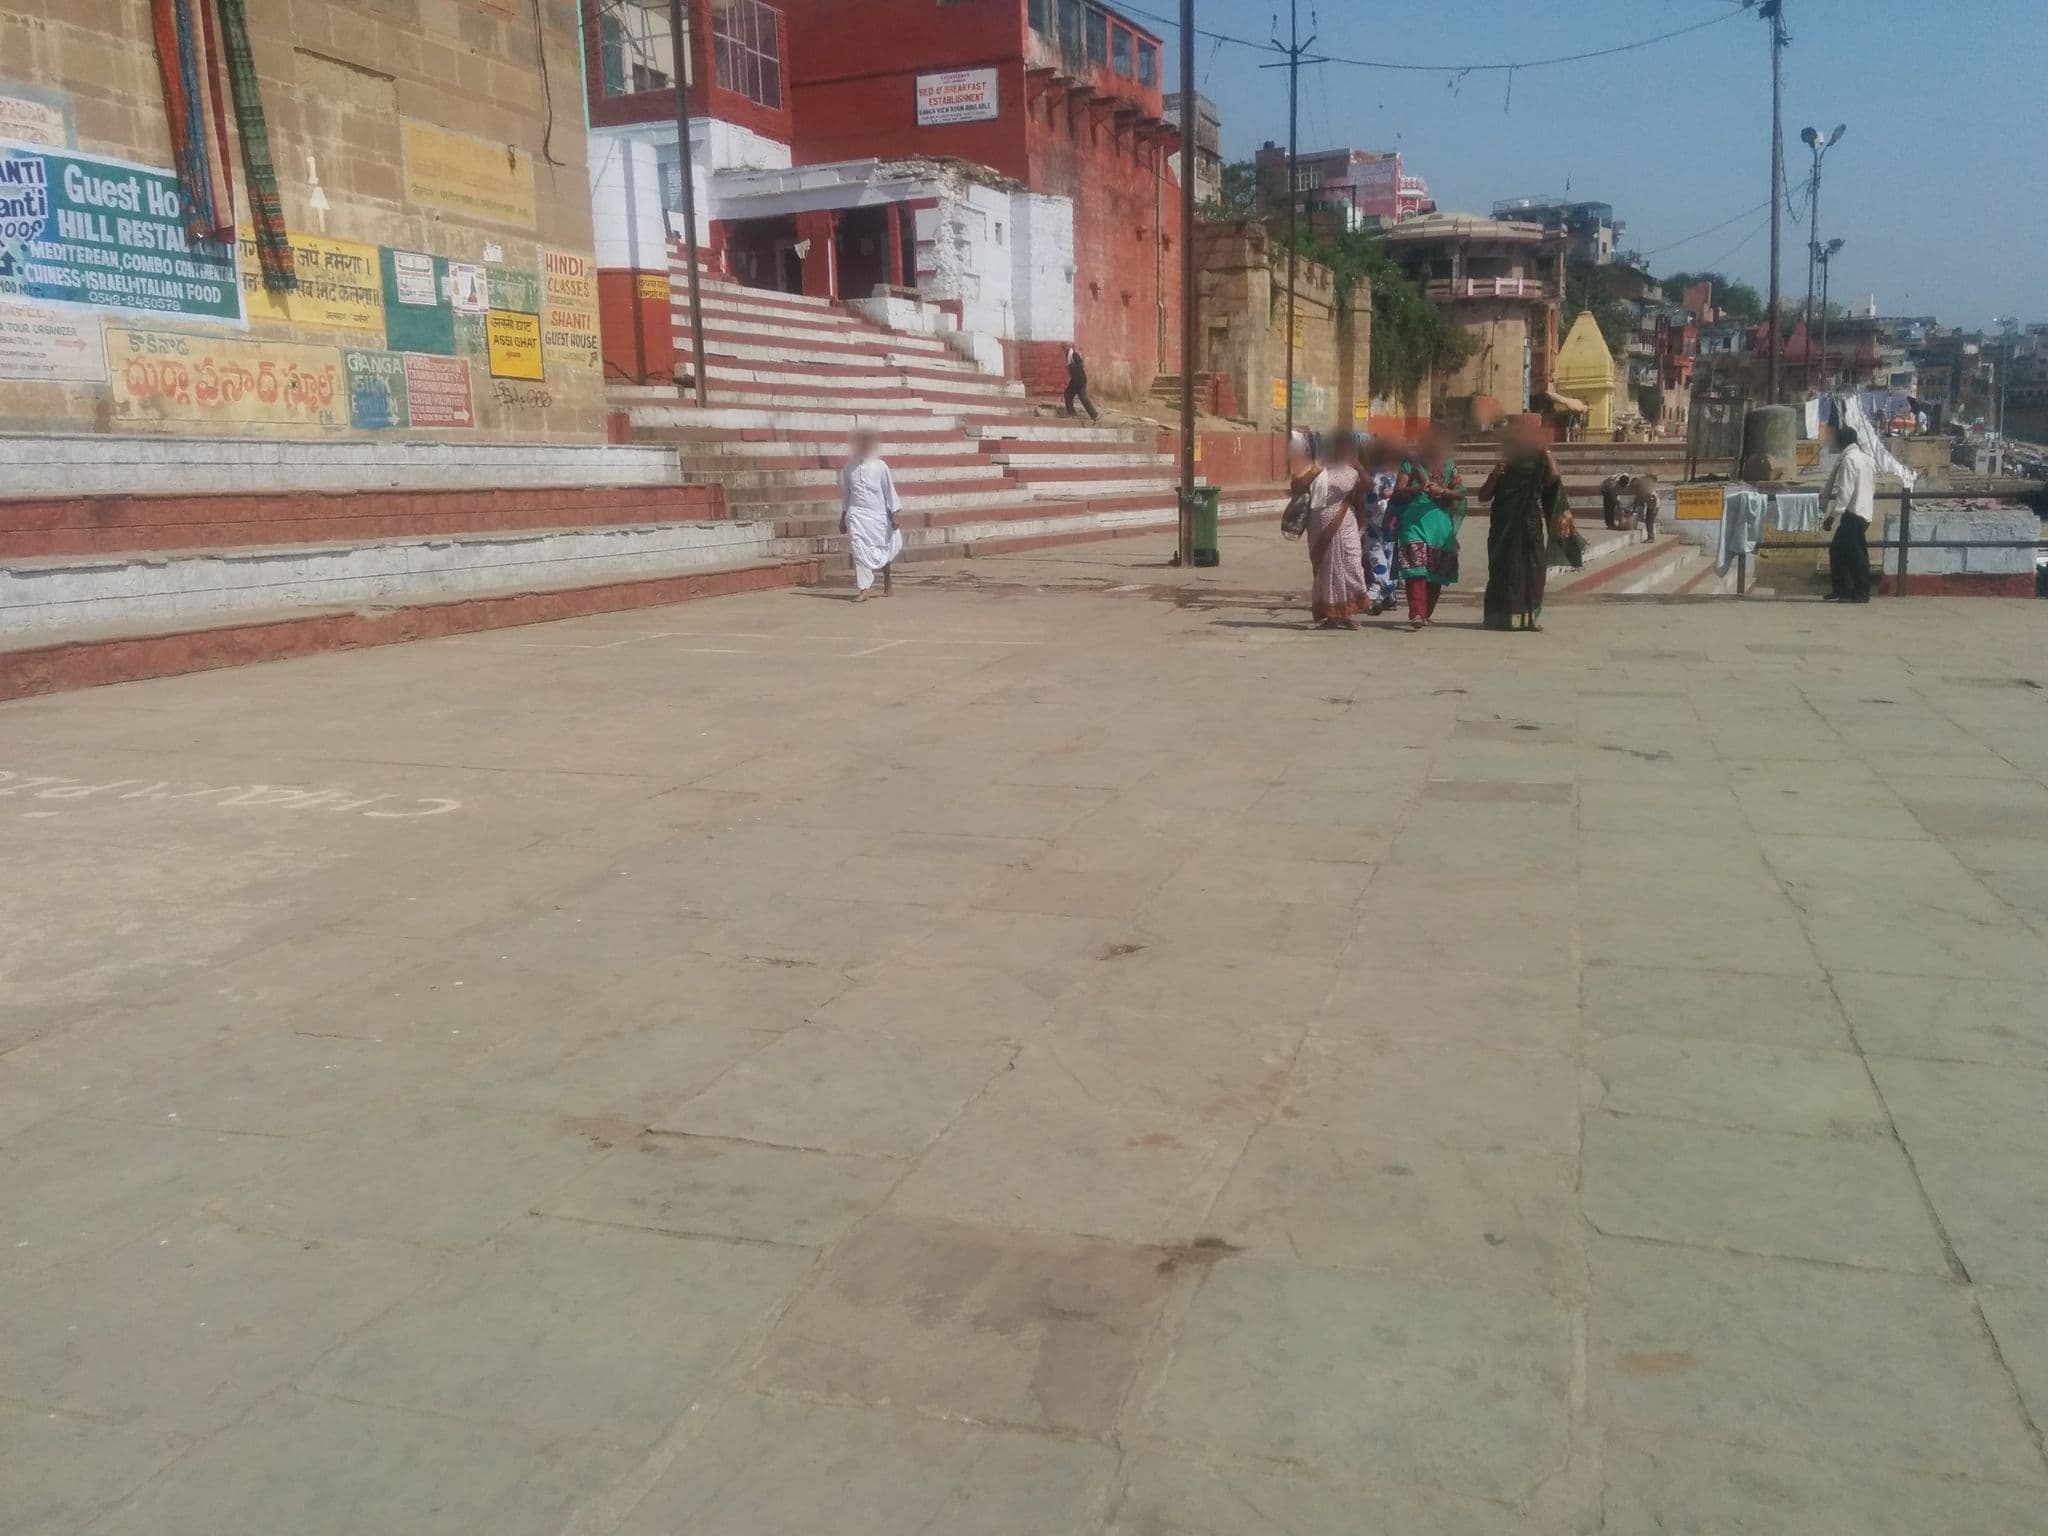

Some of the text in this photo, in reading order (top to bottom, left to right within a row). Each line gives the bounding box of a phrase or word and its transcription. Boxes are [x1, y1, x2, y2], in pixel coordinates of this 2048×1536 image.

[943, 82, 987, 94] BREAKFAST
[928, 93, 984, 106] ESTABLISHMENT
[64, 163, 181, 218] Guest Ho
[57, 208, 115, 244] HILL
[545, 252, 584, 277] HINDI
[186, 283, 222, 303] FOOD
[547, 276, 590, 298] CLASSES
[33, 324, 77, 336] ORGANIZER
[551, 310, 591, 330] SHANTI
[494, 334, 537, 349] ASSI GHAT
[545, 331, 598, 349] GUEST HOUSE
[347, 352, 404, 375] GANGA
